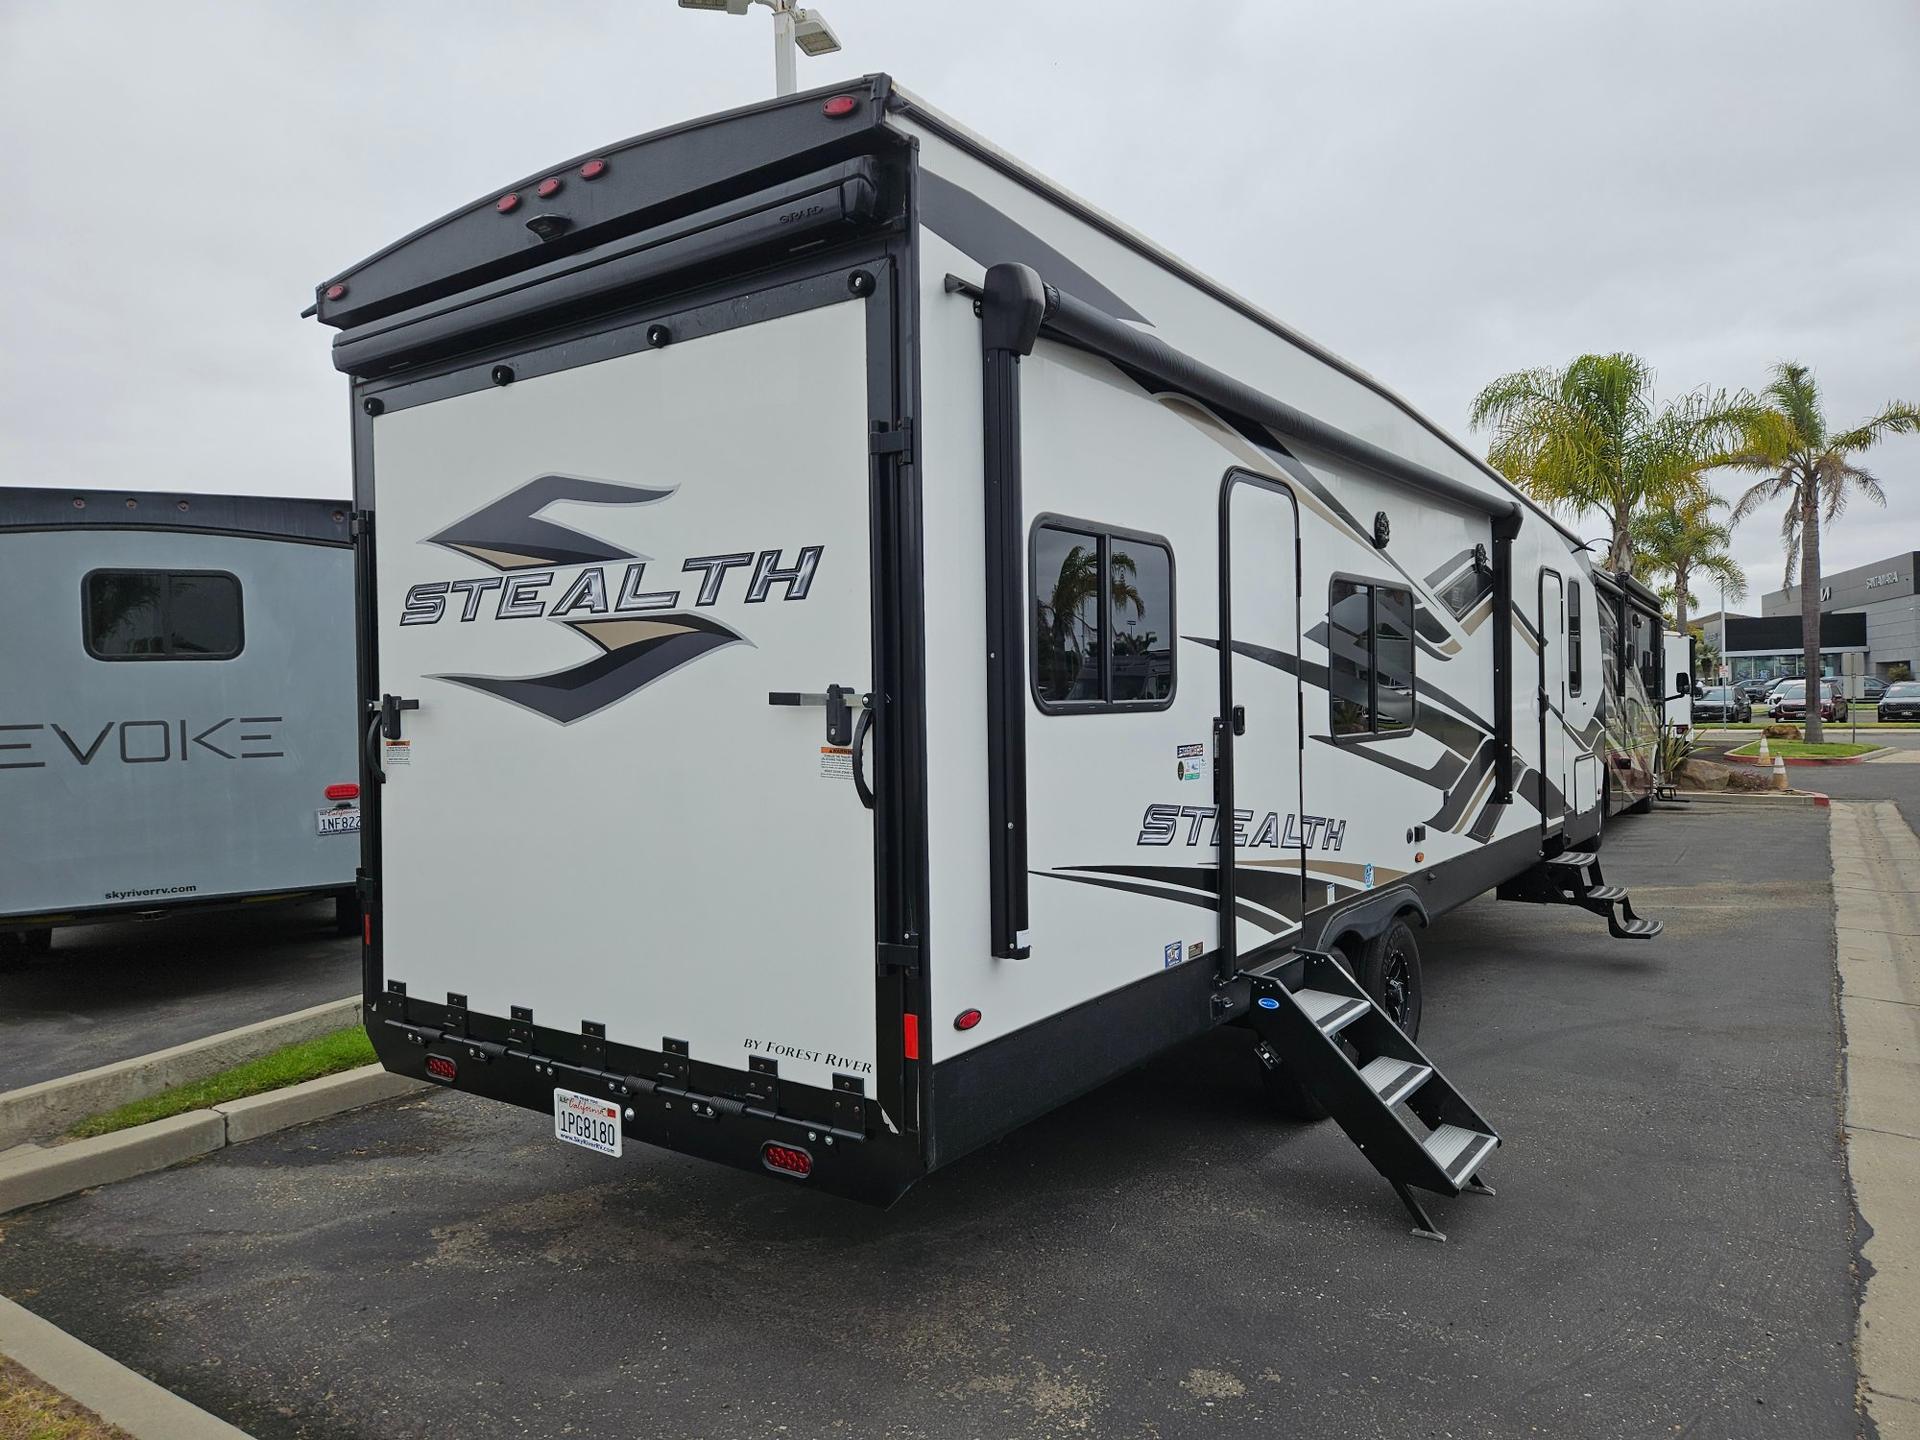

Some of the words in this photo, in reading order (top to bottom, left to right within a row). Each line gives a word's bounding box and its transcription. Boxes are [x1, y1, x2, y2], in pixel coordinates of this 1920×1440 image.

[400, 545, 825, 626] STEALTH
[0, 717, 284, 769] EVOKE
[105, 885, 196, 899] skyriverrv.com
[744, 1038, 761, 1050] BY
[766, 1041, 822, 1063] FOREST
[825, 1053, 872, 1073] RIVER
[561, 1110, 615, 1147] 1PG8180
